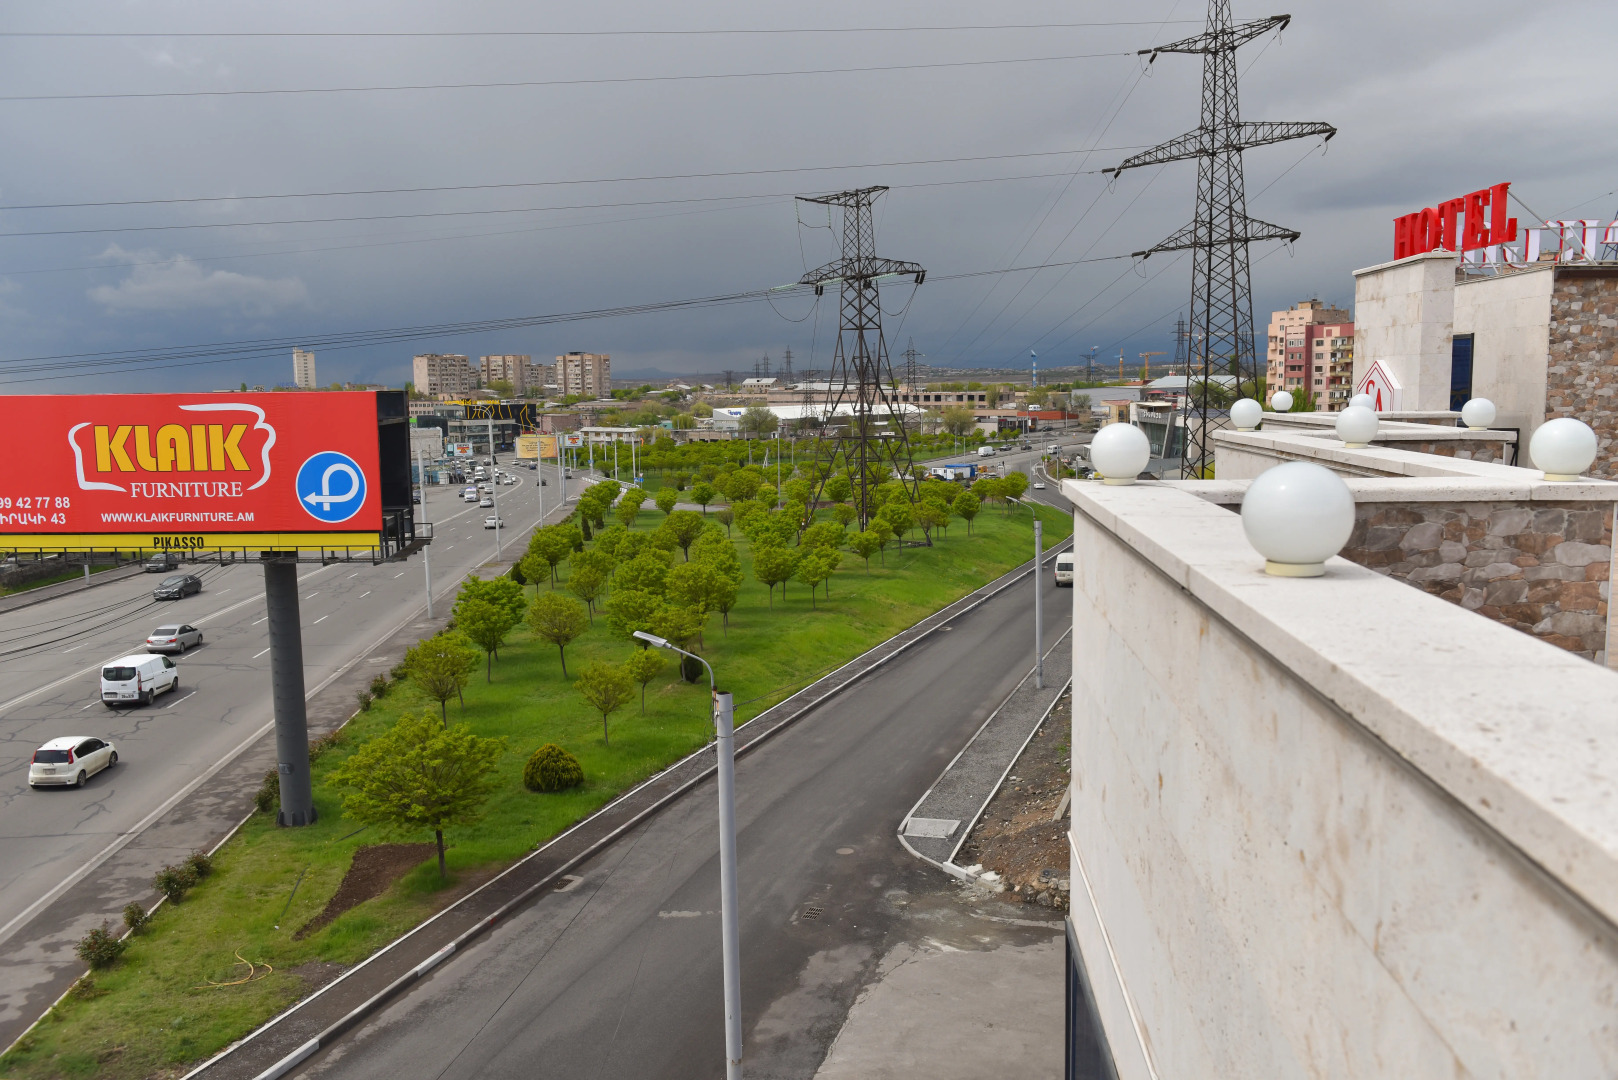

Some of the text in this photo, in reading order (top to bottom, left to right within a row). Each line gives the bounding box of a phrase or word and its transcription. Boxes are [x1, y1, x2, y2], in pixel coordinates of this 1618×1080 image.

[1393, 182, 1517, 260] HOTEL
[94, 424, 251, 472] KLAIK
[130, 482, 243, 498] FURNITURE
[16, 497, 32, 509] 42
[35, 497, 51, 509] 77
[55, 497, 71, 509] 88
[51, 513, 66, 525] 43
[101, 512, 255, 523] WWW.KLAIKFURNITURE.AM
[153, 536, 204, 549] PIKASSO
